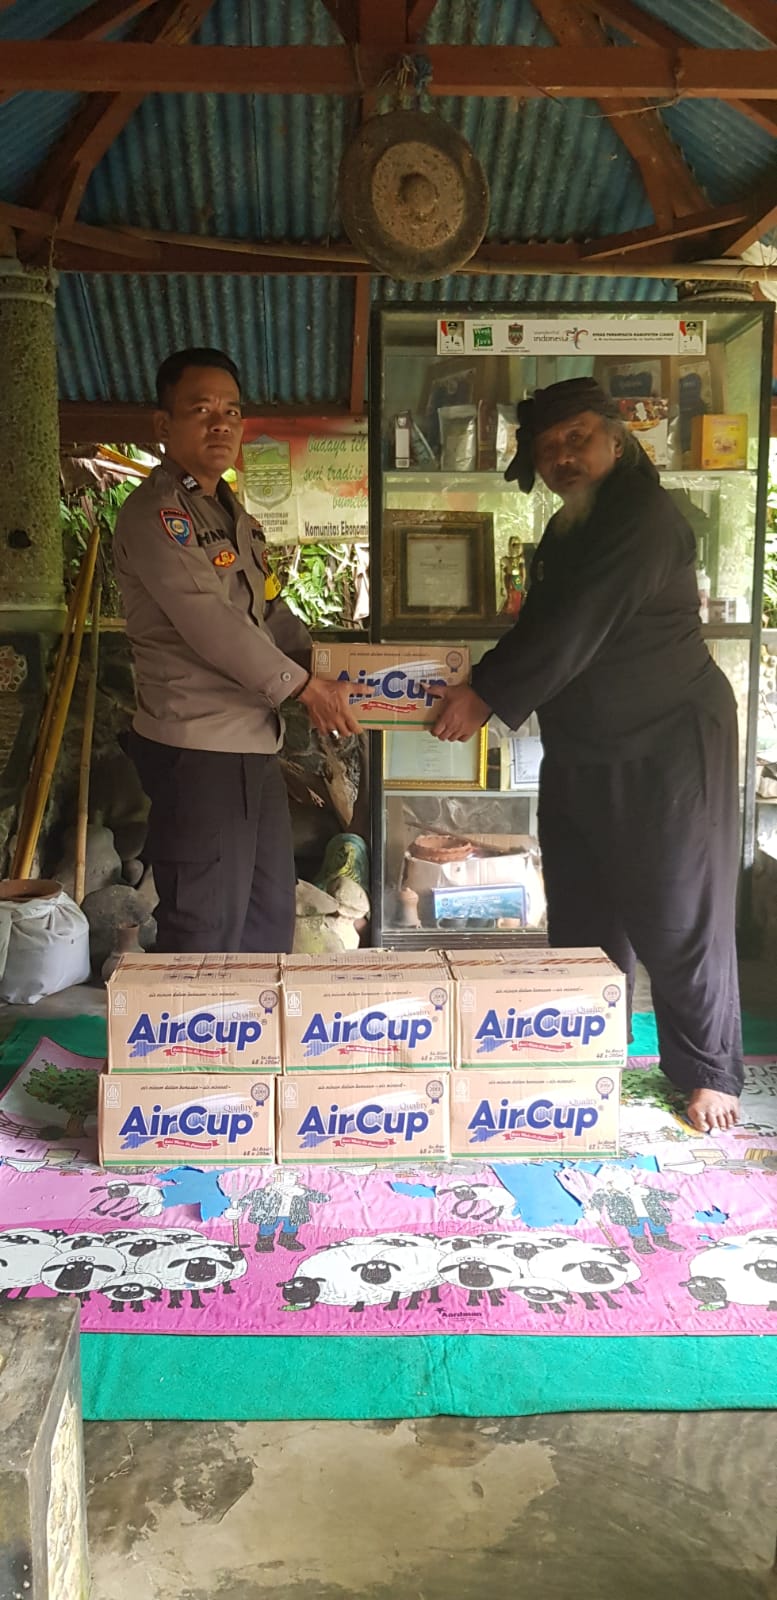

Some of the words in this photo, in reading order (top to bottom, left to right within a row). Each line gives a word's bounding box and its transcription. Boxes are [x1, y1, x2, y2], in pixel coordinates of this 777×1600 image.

[474, 326, 491, 335] West
[308, 434, 347, 458] budaya
[327, 463, 362, 481] tradisi
[304, 520, 339, 537] Komunitas
[127, 1012, 262, 1051] AirCup
[301, 1011, 432, 1048] AirCup
[475, 1008, 606, 1045] AirCup
[224, 1103, 253, 1113] Quality
[400, 1102, 427, 1111] Quality
[467, 1099, 598, 1136] AirCup
[118, 1105, 253, 1143] AirCup
[297, 1104, 429, 1141] AirCup
